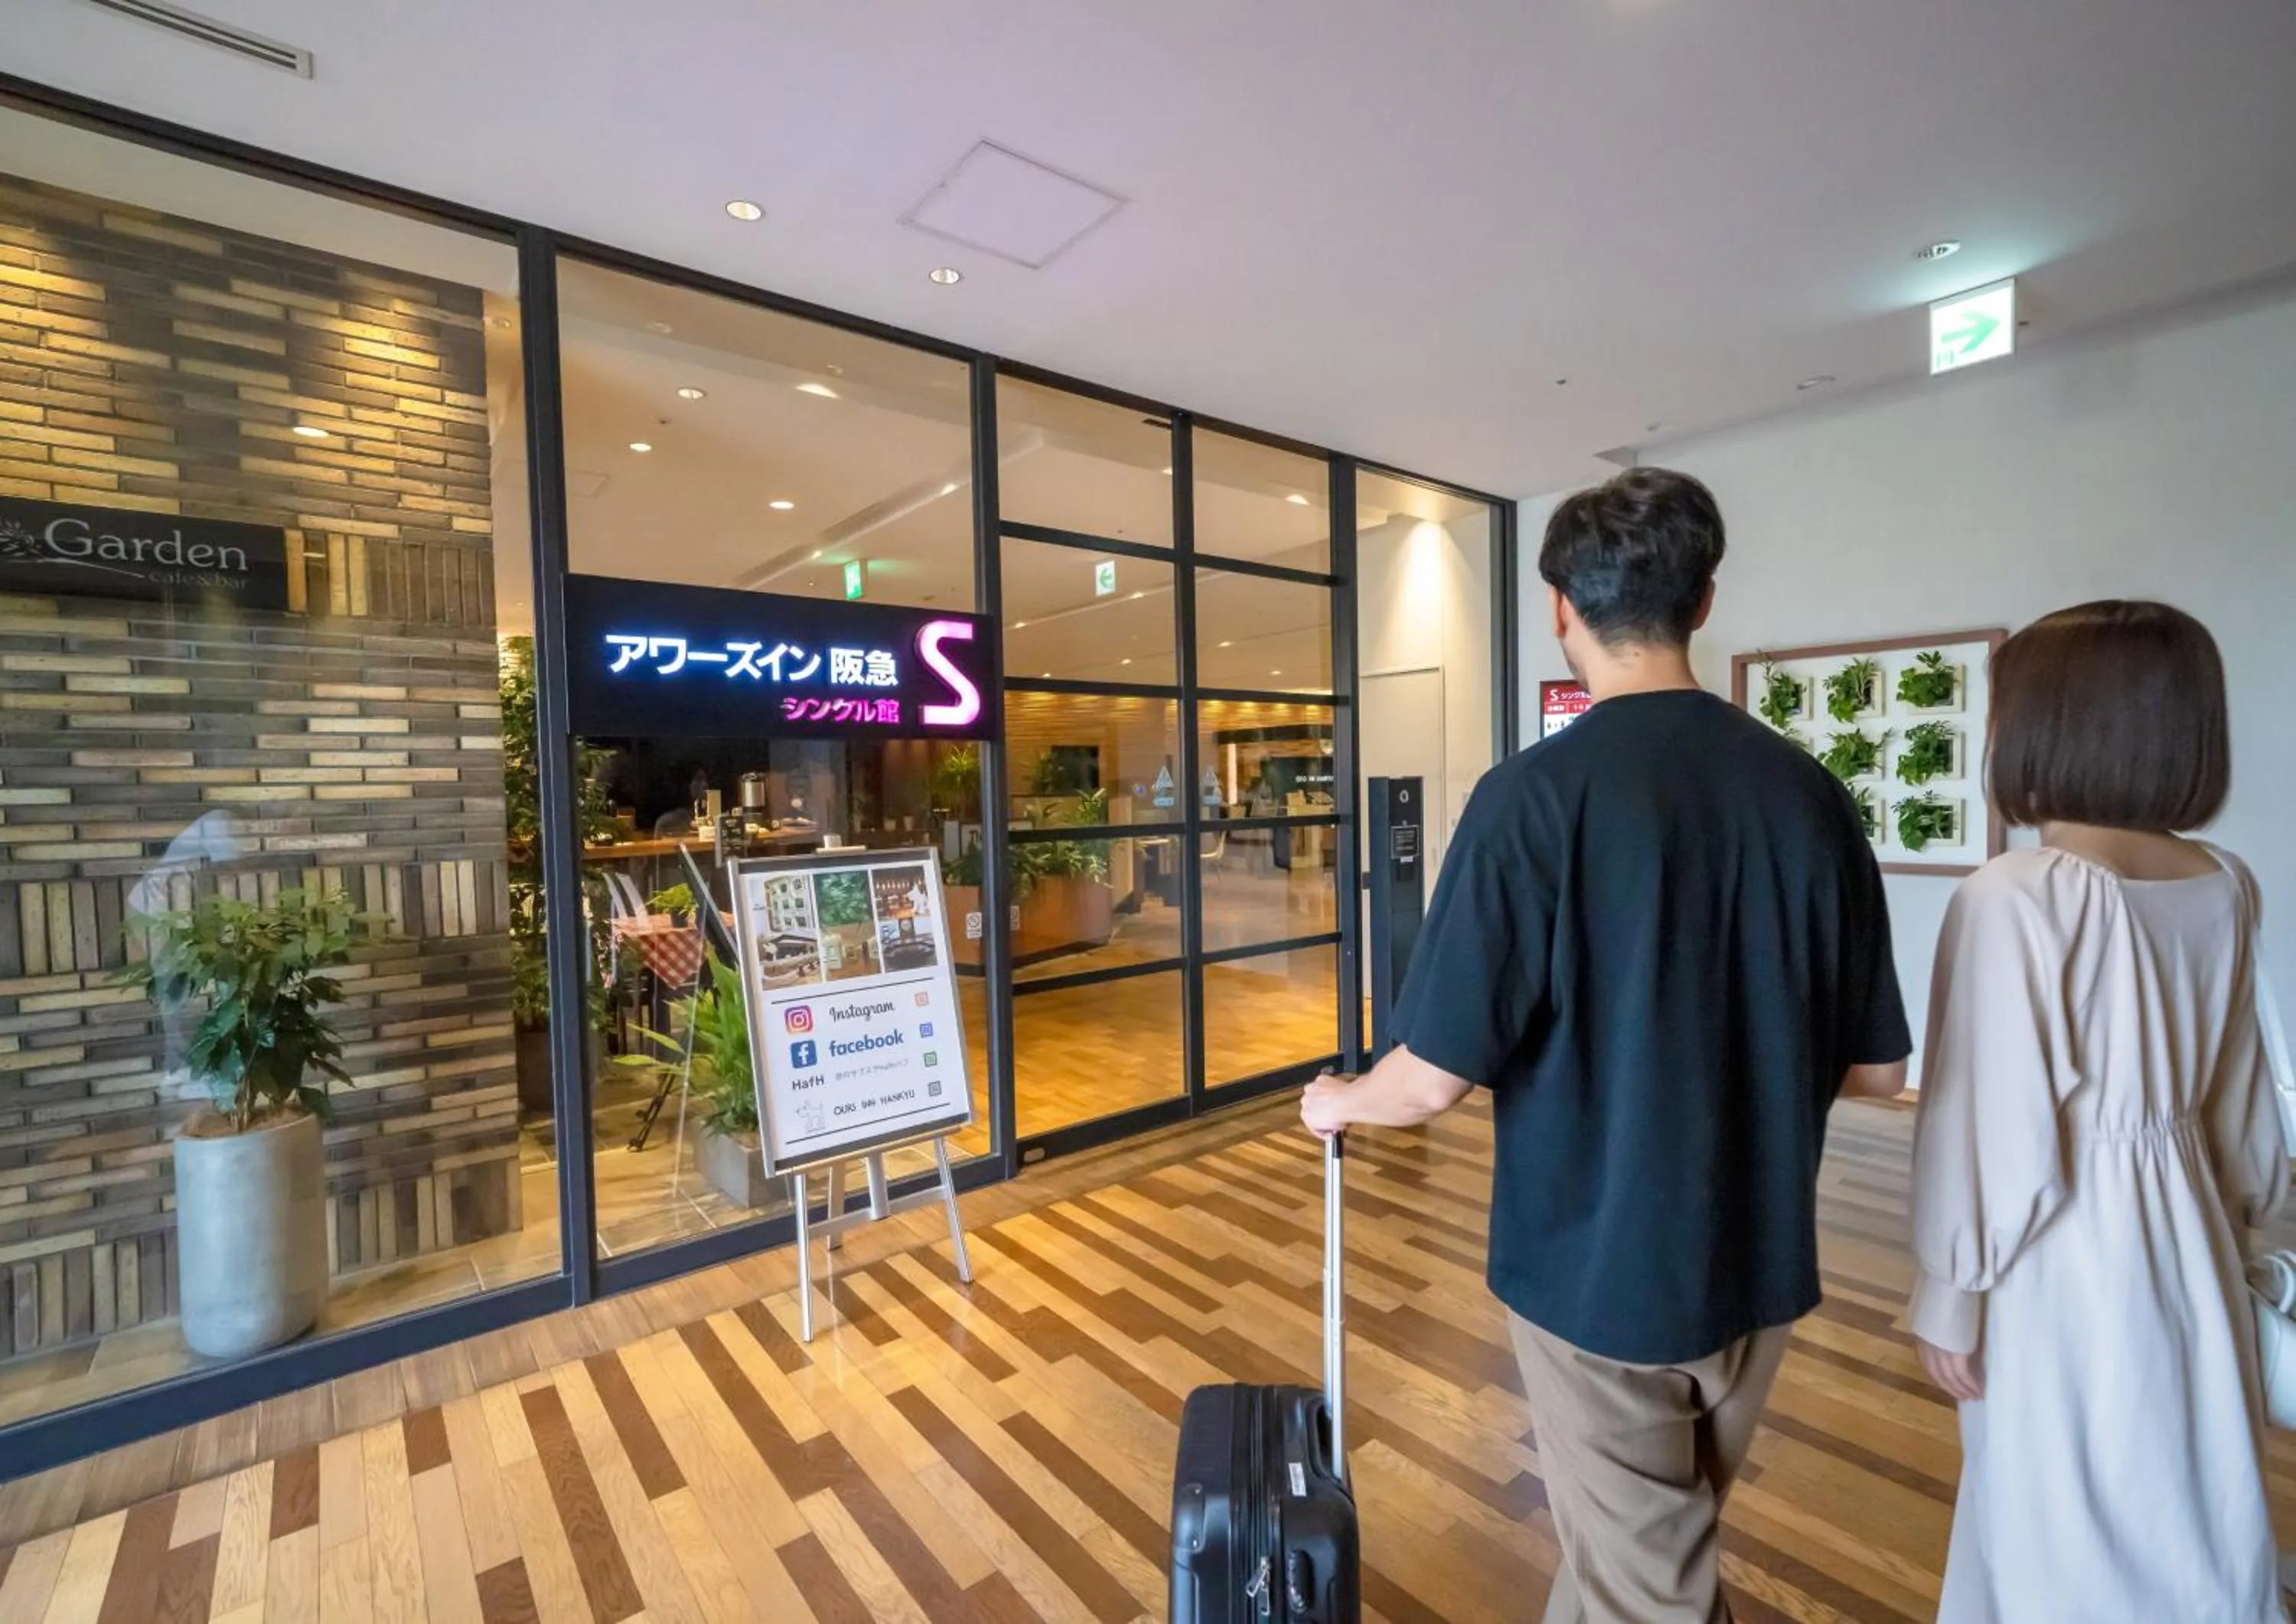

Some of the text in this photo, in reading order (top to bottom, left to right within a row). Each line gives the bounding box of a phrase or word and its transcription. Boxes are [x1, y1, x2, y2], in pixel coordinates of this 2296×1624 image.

[44, 518, 248, 570] Garden
[605, 634, 899, 686] アワーズイン 阪急
[917, 620, 981, 725] S
[783, 697, 900, 723] シングル館
[829, 1002, 894, 1022] Instagram
[830, 1029, 904, 1056] facebook
[791, 1075, 825, 1091] HafH
[879, 1089, 915, 1105] HANKYU
